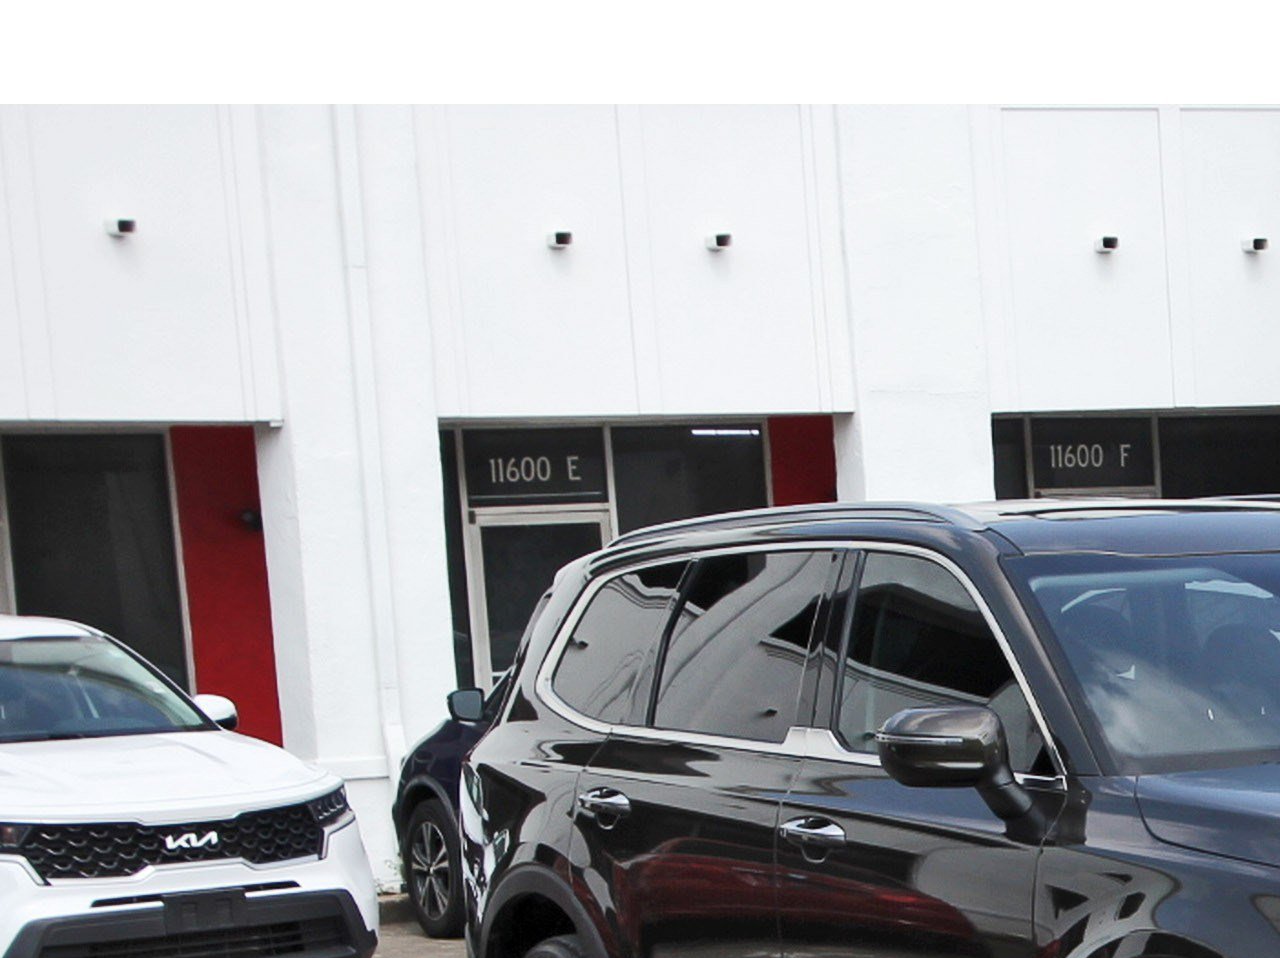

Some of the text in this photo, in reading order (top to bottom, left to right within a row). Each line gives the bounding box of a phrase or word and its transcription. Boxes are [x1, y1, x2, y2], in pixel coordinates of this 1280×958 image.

[1050, 443, 1131, 468] 11600 F
[489, 456, 582, 483] 11600 E
